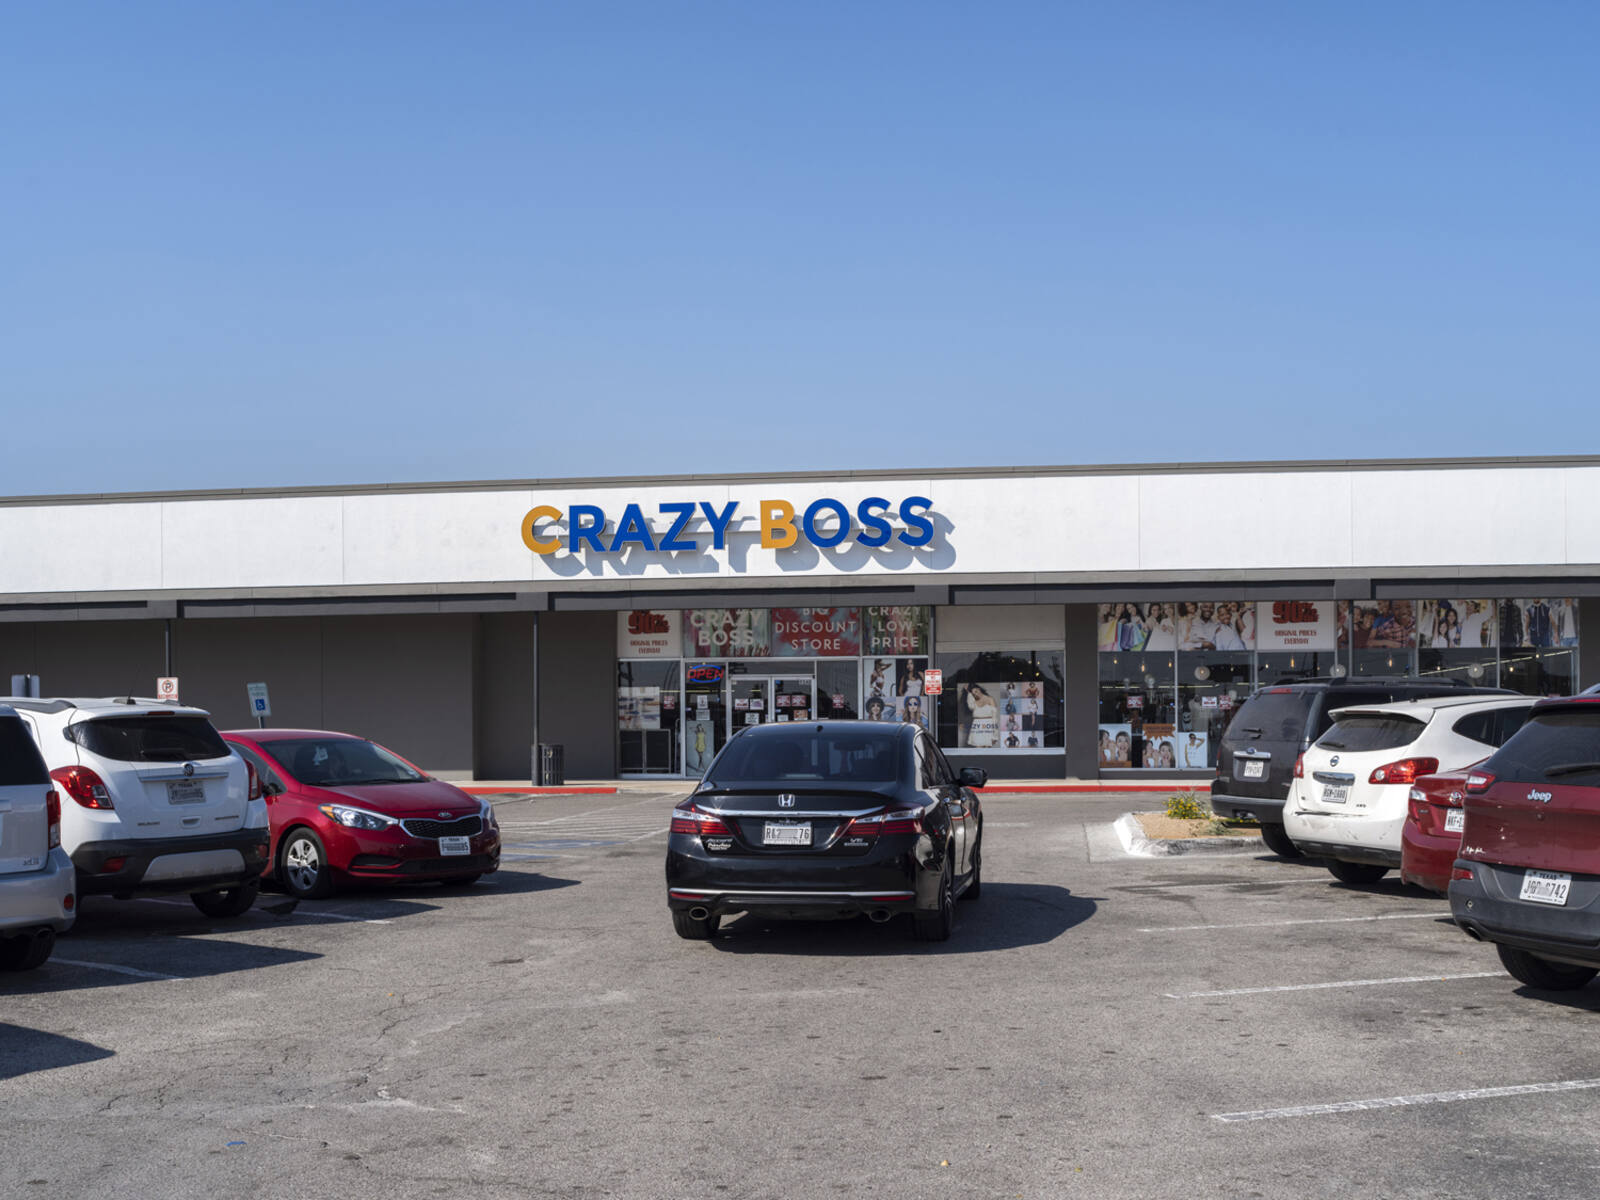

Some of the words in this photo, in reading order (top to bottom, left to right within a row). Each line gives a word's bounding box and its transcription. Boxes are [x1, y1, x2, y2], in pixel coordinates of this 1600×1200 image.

[521, 501, 740, 555] CRAZY
[760, 496, 934, 549] BOSS
[802, 608, 829, 616] BIG
[868, 606, 921, 616] CRAZY
[690, 609, 764, 628] CRAZY
[775, 621, 857, 633] DISCOUNT
[698, 629, 754, 646] BOSS
[871, 636, 919, 648] PRICE
[791, 638, 841, 650] STORE
[687, 668, 725, 680] OPEN
[1527, 789, 1552, 803] Jeep
[1539, 872, 1557, 880] TEXAS
